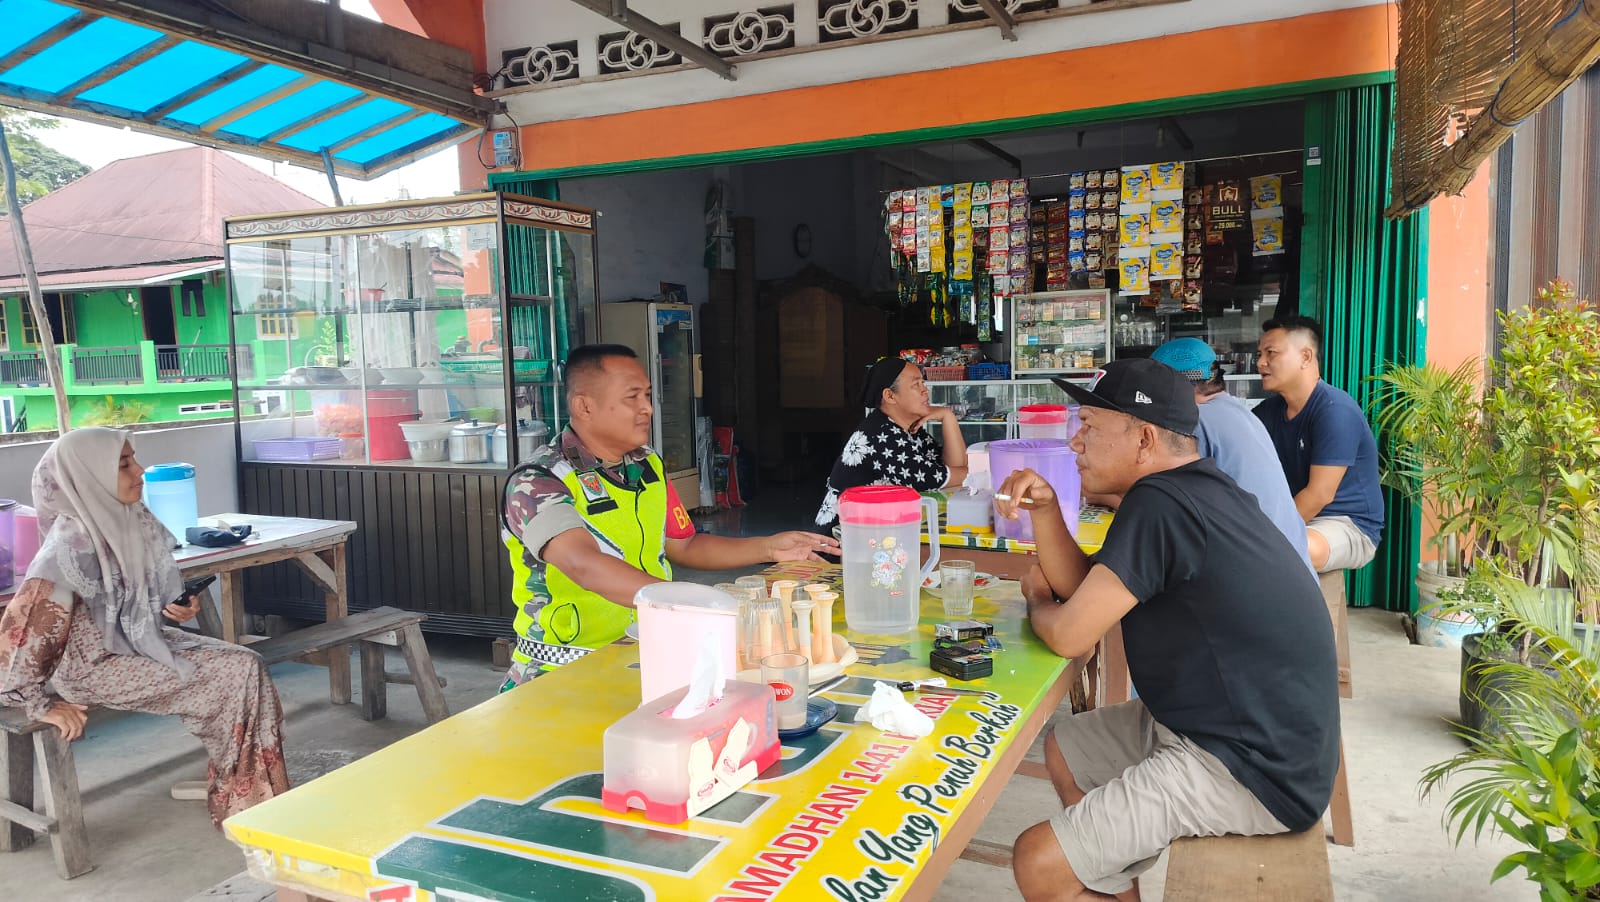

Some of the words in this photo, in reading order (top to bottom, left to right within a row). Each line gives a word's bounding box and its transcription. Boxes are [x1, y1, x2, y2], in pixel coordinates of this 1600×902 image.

[1212, 206, 1245, 216] BULL
[775, 687, 792, 696] WON
[843, 743, 909, 782] 1441
[859, 814, 939, 864] Yang
[903, 753, 979, 814] Penuh
